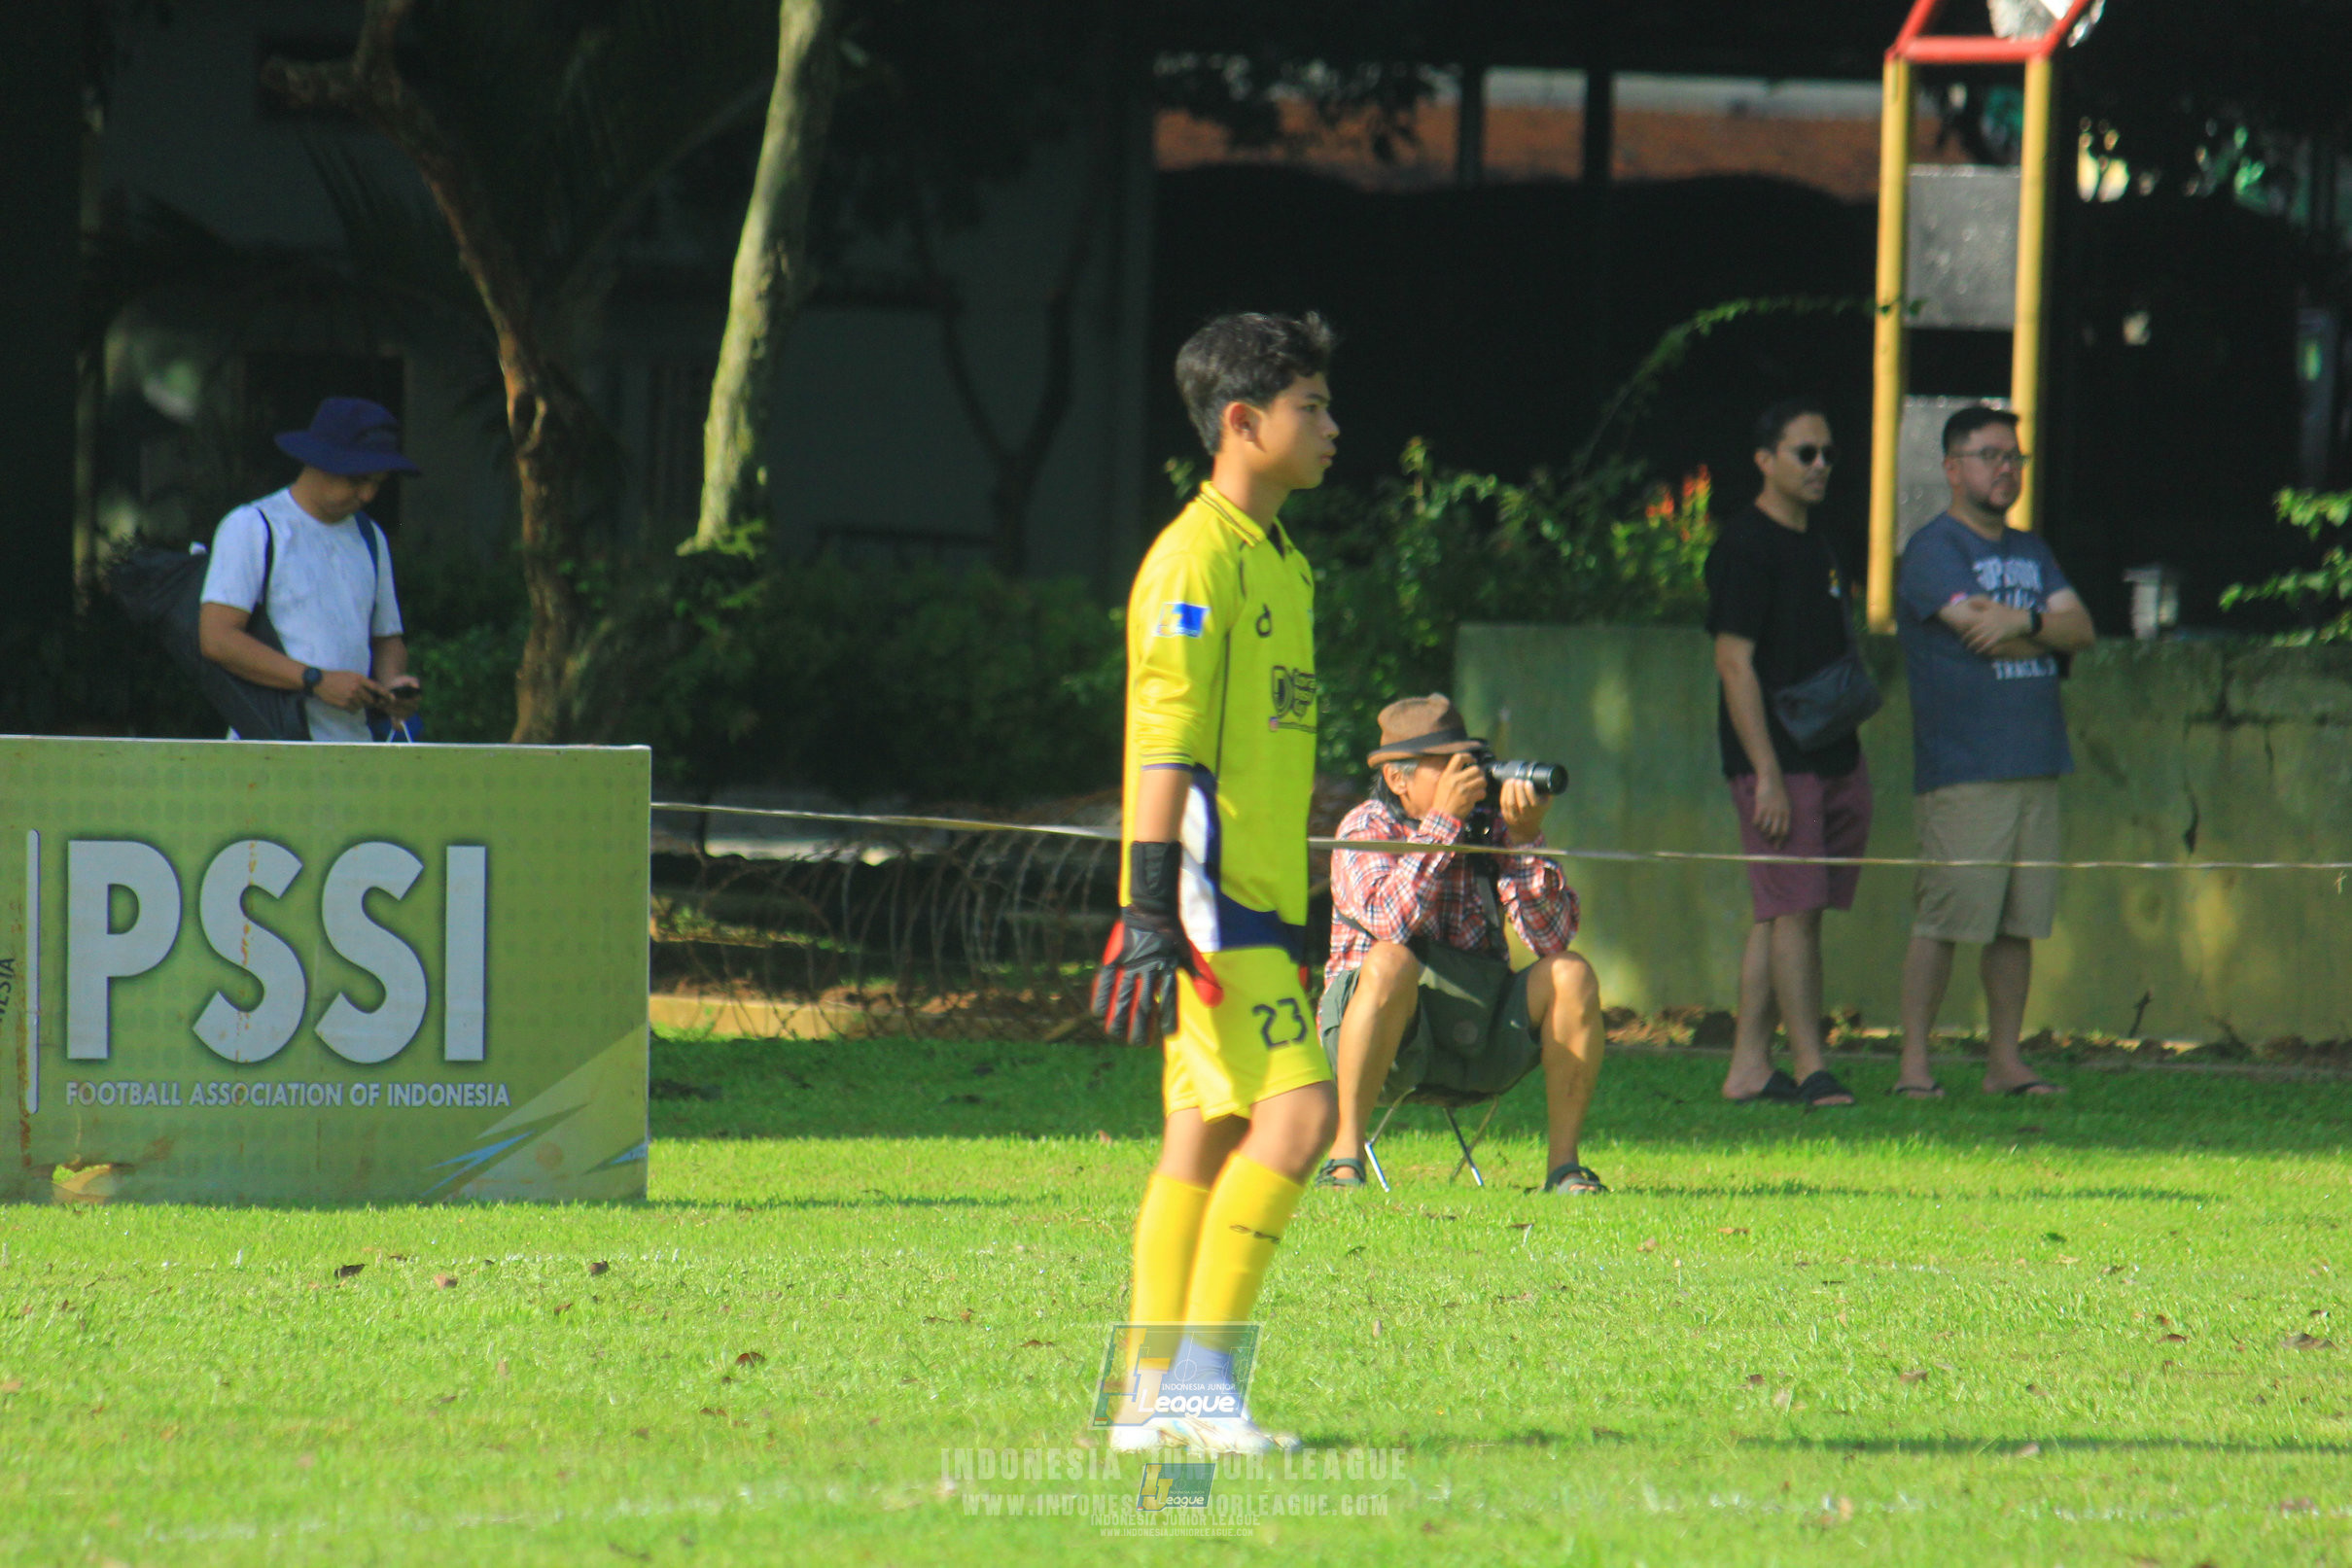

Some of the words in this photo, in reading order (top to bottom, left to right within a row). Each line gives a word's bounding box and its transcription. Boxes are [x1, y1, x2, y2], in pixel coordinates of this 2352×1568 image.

[67, 840, 487, 1064] PSSI
[1252, 997, 1309, 1050] 23
[66, 1081, 182, 1106] FOOTBALL
[190, 1082, 342, 1107] ASSOCIATION
[349, 1083, 381, 1107] OF
[387, 1083, 510, 1107] INDONESIA
